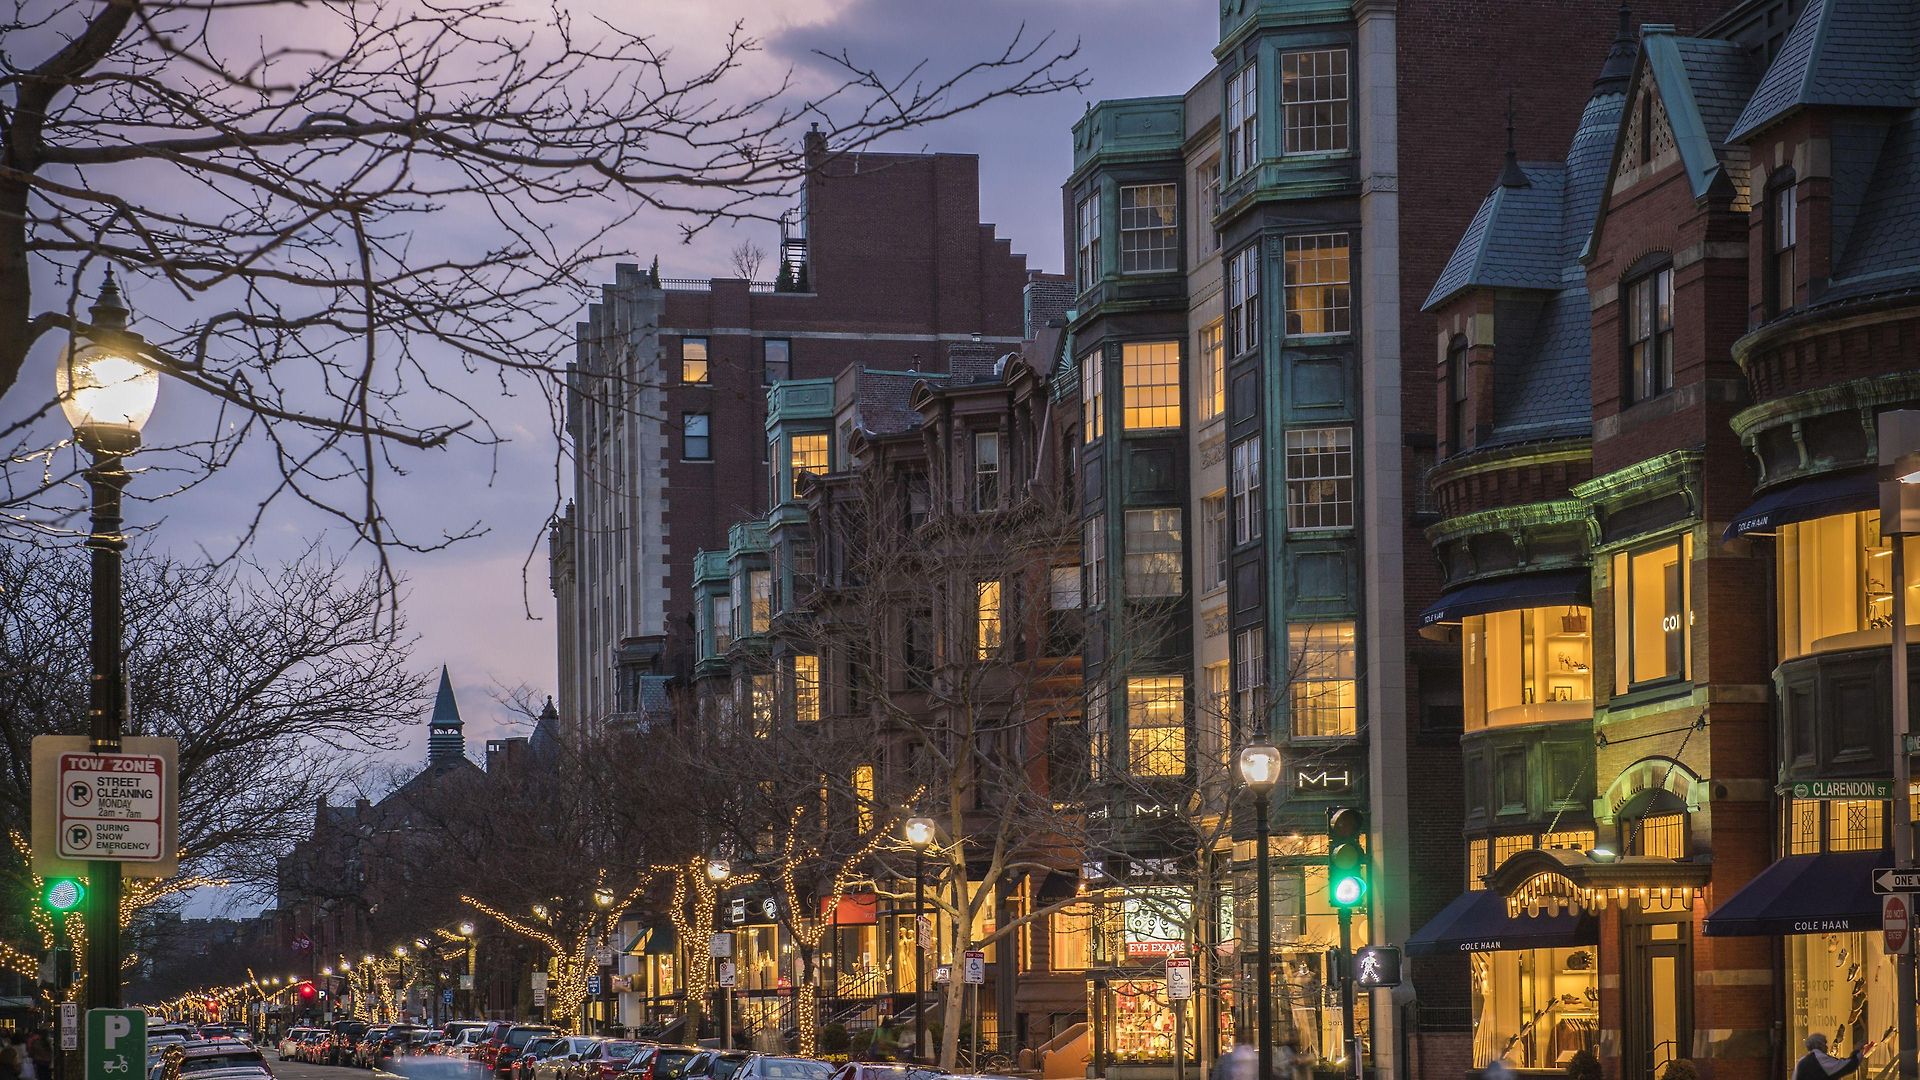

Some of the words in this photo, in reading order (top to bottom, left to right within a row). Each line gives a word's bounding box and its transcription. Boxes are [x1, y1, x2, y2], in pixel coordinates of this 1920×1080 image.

[67, 757, 105, 770] TOW
[112, 759, 156, 773] ZONE
[97, 776, 141, 787] STREET
[1299, 770, 1348, 787] MH
[97, 788, 153, 799] CLEANING
[1813, 781, 1875, 796] CLARENDON
[1877, 786, 1886, 796] ST
[98, 798, 132, 809] MONDAY
[98, 808, 115, 817] 2am
[126, 809, 141, 818] 7am
[96, 824, 130, 832] DURING
[96, 833, 123, 841] SNOW
[96, 842, 151, 850] EMERGENCY
[1894, 875, 1913, 886] ONE
[1794, 921, 1818, 931] COLE
[1821, 919, 1849, 930] HAAN
[1129, 943, 1149, 952] EYE
[1151, 943, 1185, 952] EXAMS
[1460, 942, 1479, 951] COLE
[1480, 941, 1501, 950] HAAN
[1823, 979, 1835, 992] OF
